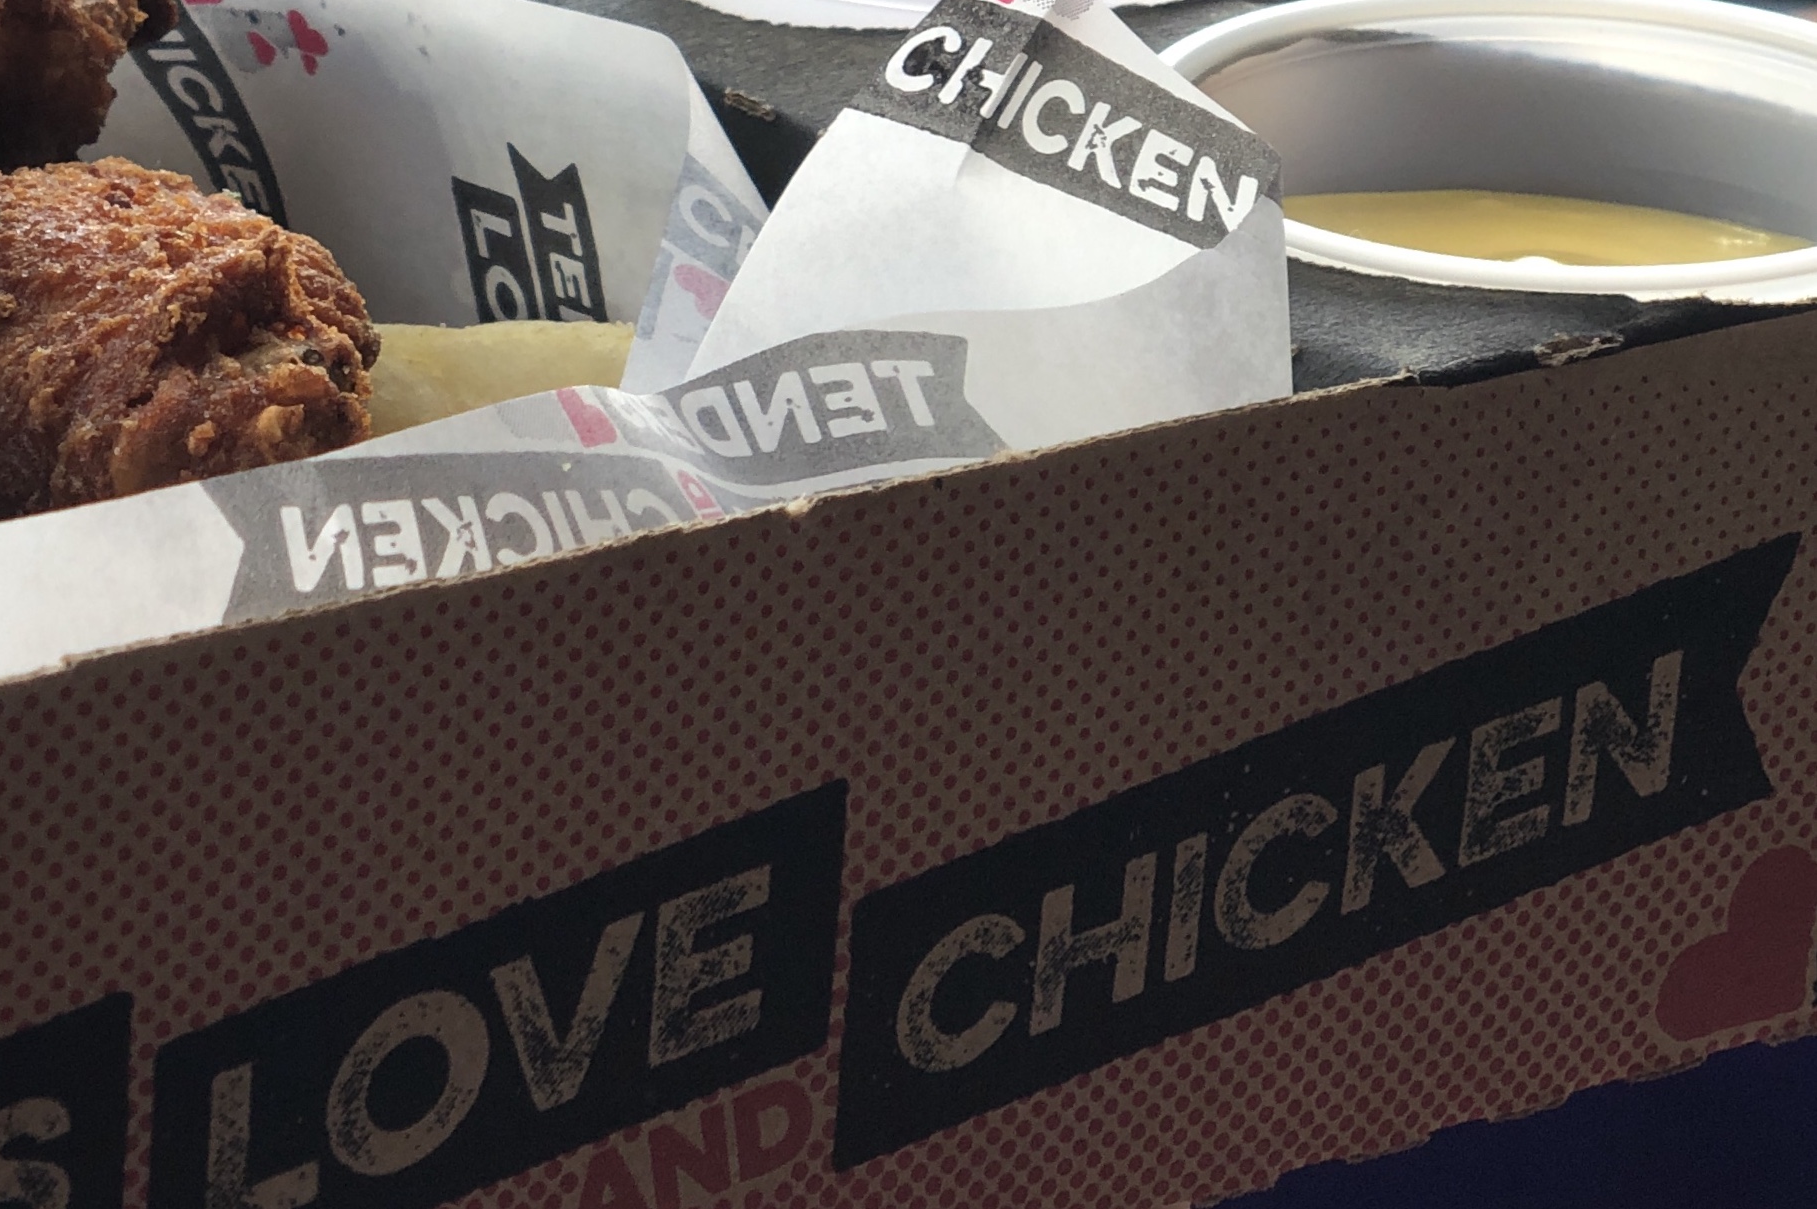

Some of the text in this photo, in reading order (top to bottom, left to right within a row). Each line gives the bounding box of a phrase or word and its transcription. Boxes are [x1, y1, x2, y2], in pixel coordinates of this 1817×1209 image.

[884, 26, 1260, 233] CHICKEN
[895, 650, 1682, 1076] CHICKEN
[205, 863, 772, 1209] LOVE
[577, 1079, 814, 1209] AND
